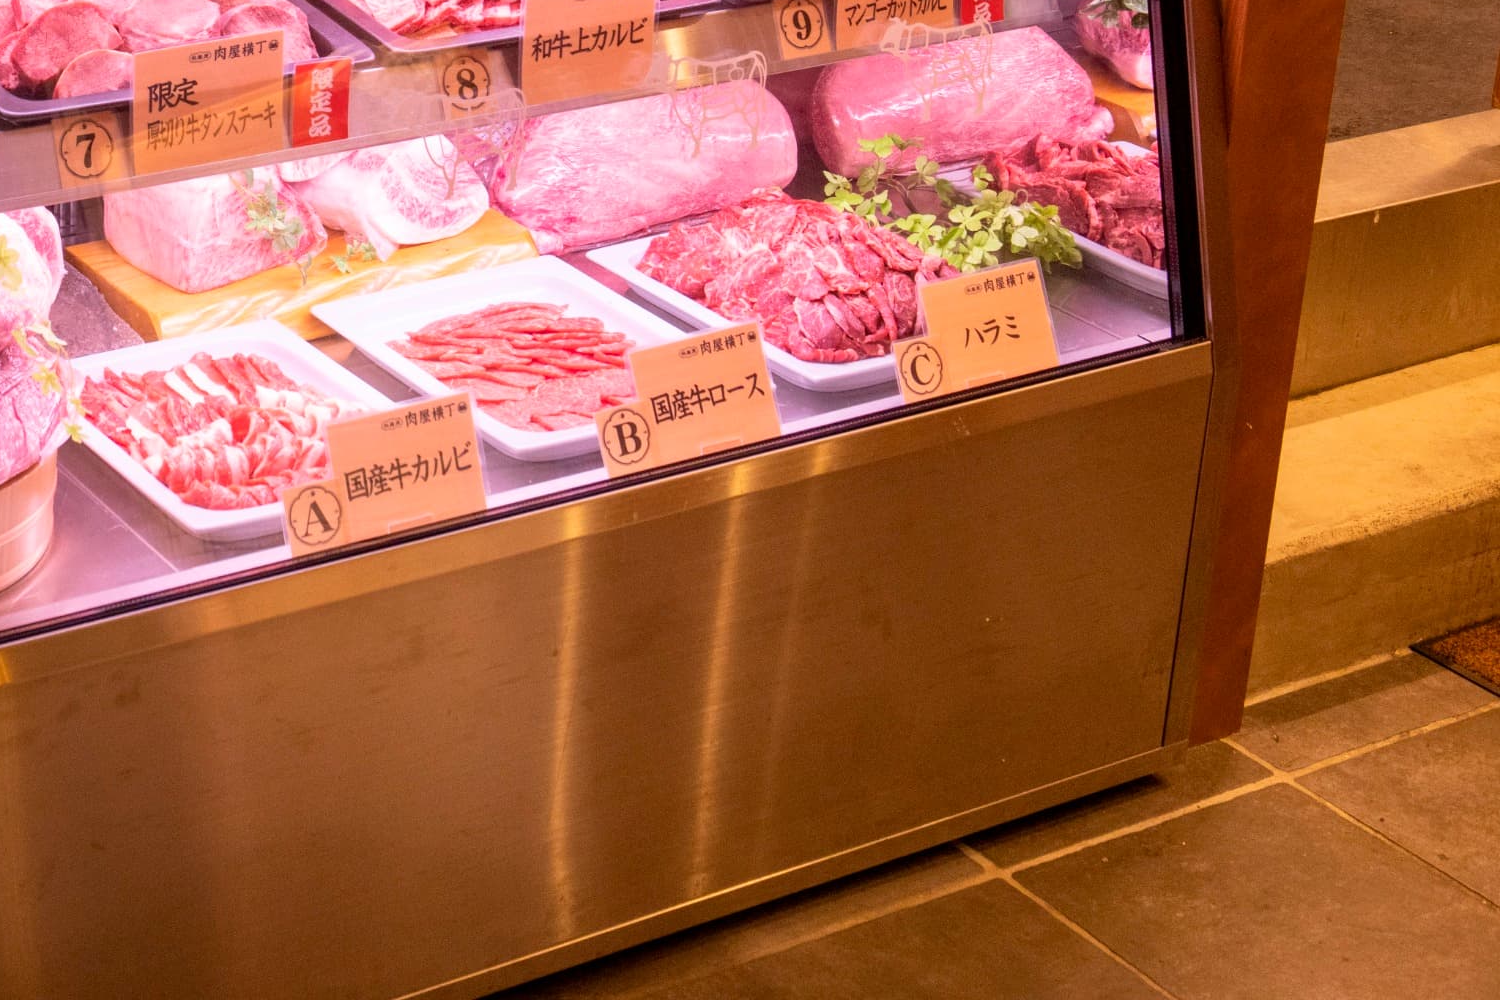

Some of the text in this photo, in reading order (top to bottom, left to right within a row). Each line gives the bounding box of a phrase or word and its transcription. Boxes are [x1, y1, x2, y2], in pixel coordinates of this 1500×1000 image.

[531, 17, 649, 62] 和牛上カルビ
[792, 9, 812, 40] 9
[213, 39, 269, 62] 肉屋横丁
[147, 77, 200, 114] 限定
[457, 68, 479, 101] 8
[308, 67, 334, 138] 限定品
[75, 133, 95, 168] 7
[984, 272, 1025, 293] 肉屋横丁
[699, 332, 746, 356] 肉屋横丁
[964, 315, 1021, 349] ハラミ
[910, 354, 935, 386] C
[405, 403, 456, 426] 肉屋横丁
[650, 372, 765, 425] 国産牛ロース
[613, 421, 643, 457] B
[344, 441, 473, 501] 国産牛カルビ
[301, 500, 334, 537] A
